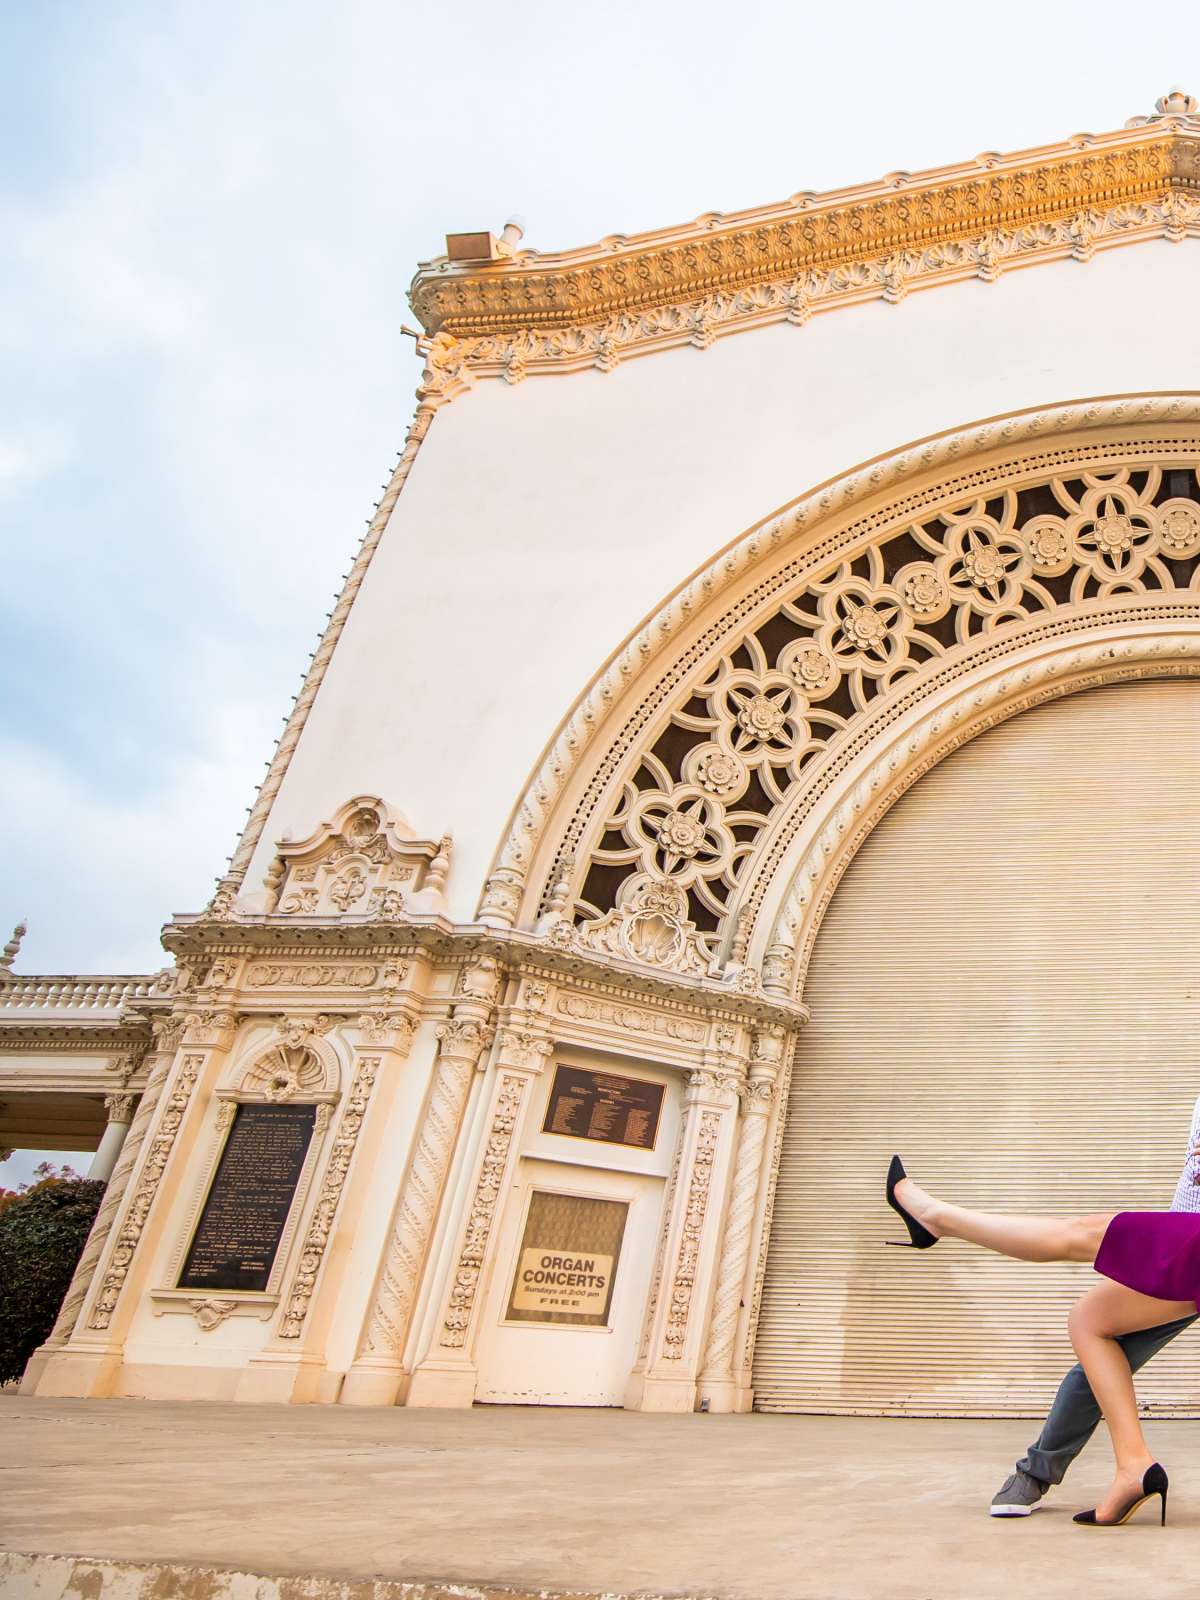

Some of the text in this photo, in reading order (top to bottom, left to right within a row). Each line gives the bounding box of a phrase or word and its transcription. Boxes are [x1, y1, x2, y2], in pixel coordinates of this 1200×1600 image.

[541, 1256, 594, 1272] ORGAN
[523, 1270, 605, 1288] CONCERTS
[524, 1286, 557, 1295] Sundays
[540, 1298, 580, 1306] FREE
